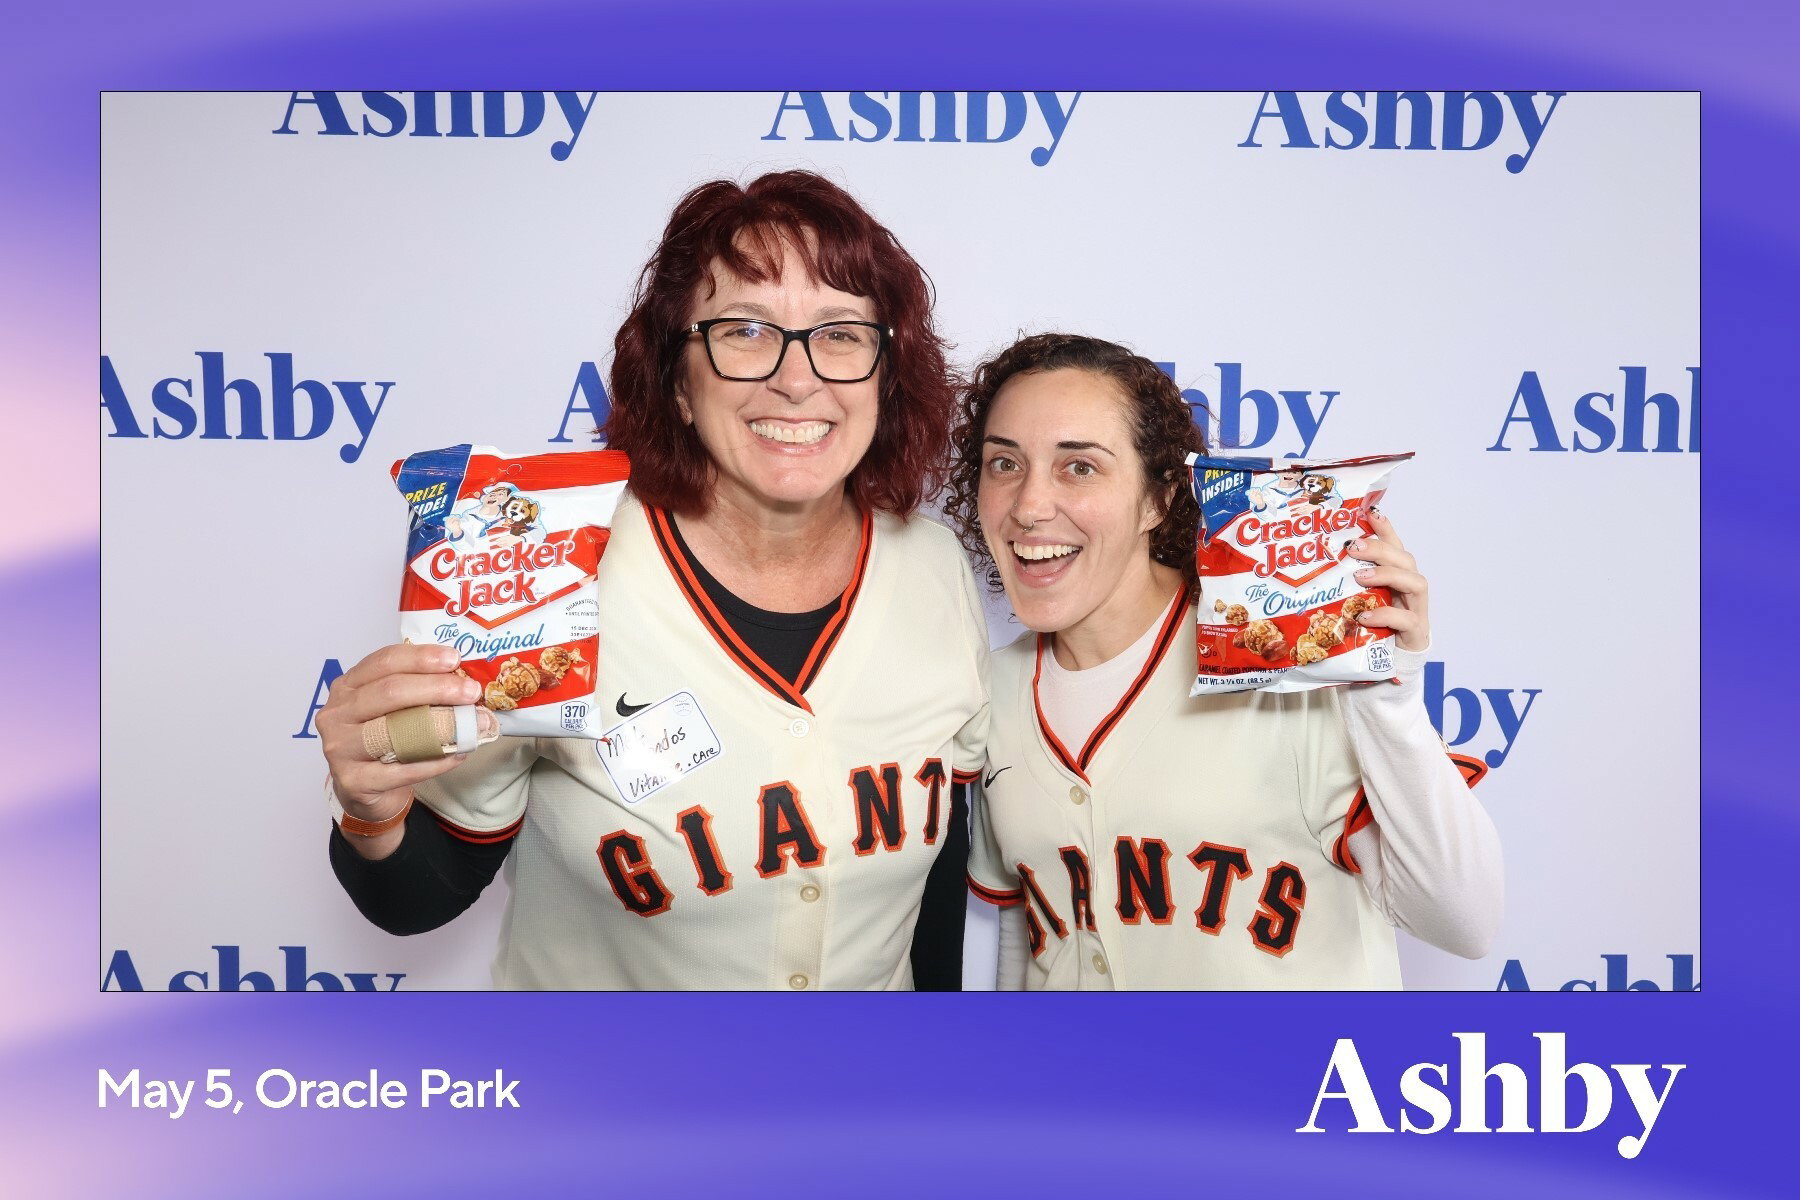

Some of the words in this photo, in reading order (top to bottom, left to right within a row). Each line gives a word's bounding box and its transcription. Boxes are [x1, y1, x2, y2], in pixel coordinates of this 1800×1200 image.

[1488, 367, 1699, 453] Ash
[405, 482, 447, 503] PRIZE
[1201, 472, 1244, 504] INSIDE!
[1236, 508, 1361, 547] Cracker
[429, 539, 576, 582] Cracker
[1254, 535, 1334, 578] Jack
[445, 574, 538, 618] Jack
[1244, 583, 1269, 603] The
[434, 622, 459, 643] The
[454, 623, 545, 662] Original
[1198, 677, 1208, 685] NET
[565, 706, 586, 718] 370
[1016, 835, 1307, 960] IANTS
